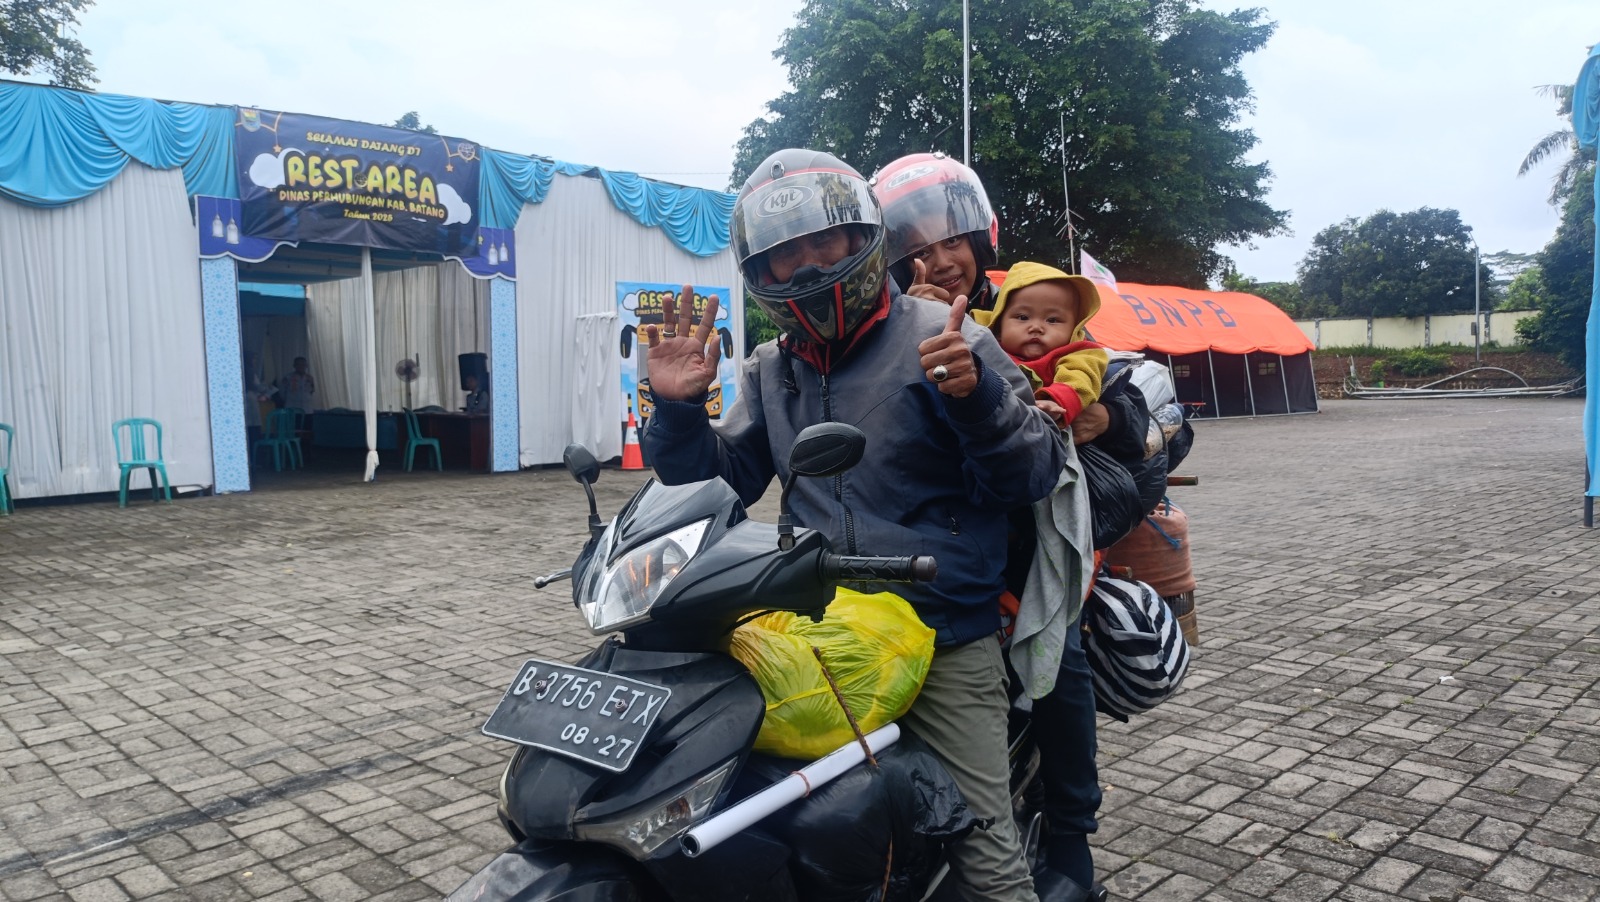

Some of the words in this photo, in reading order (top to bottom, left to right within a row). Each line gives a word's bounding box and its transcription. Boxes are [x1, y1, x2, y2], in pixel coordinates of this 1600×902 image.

[307, 132, 359, 148] SELAMAT
[361, 140, 405, 155] DATANG
[287, 155, 359, 189] REST
[367, 165, 436, 205] AREA
[279, 190, 310, 202] DINAS
[386, 199, 408, 212] KAB.
[409, 202, 445, 218] BATANG
[343, 208, 370, 220] Tahun
[1120, 294, 1236, 328] BNPB
[513, 666, 537, 696] B
[536, 671, 601, 709] 3756
[600, 685, 661, 726] ETX
